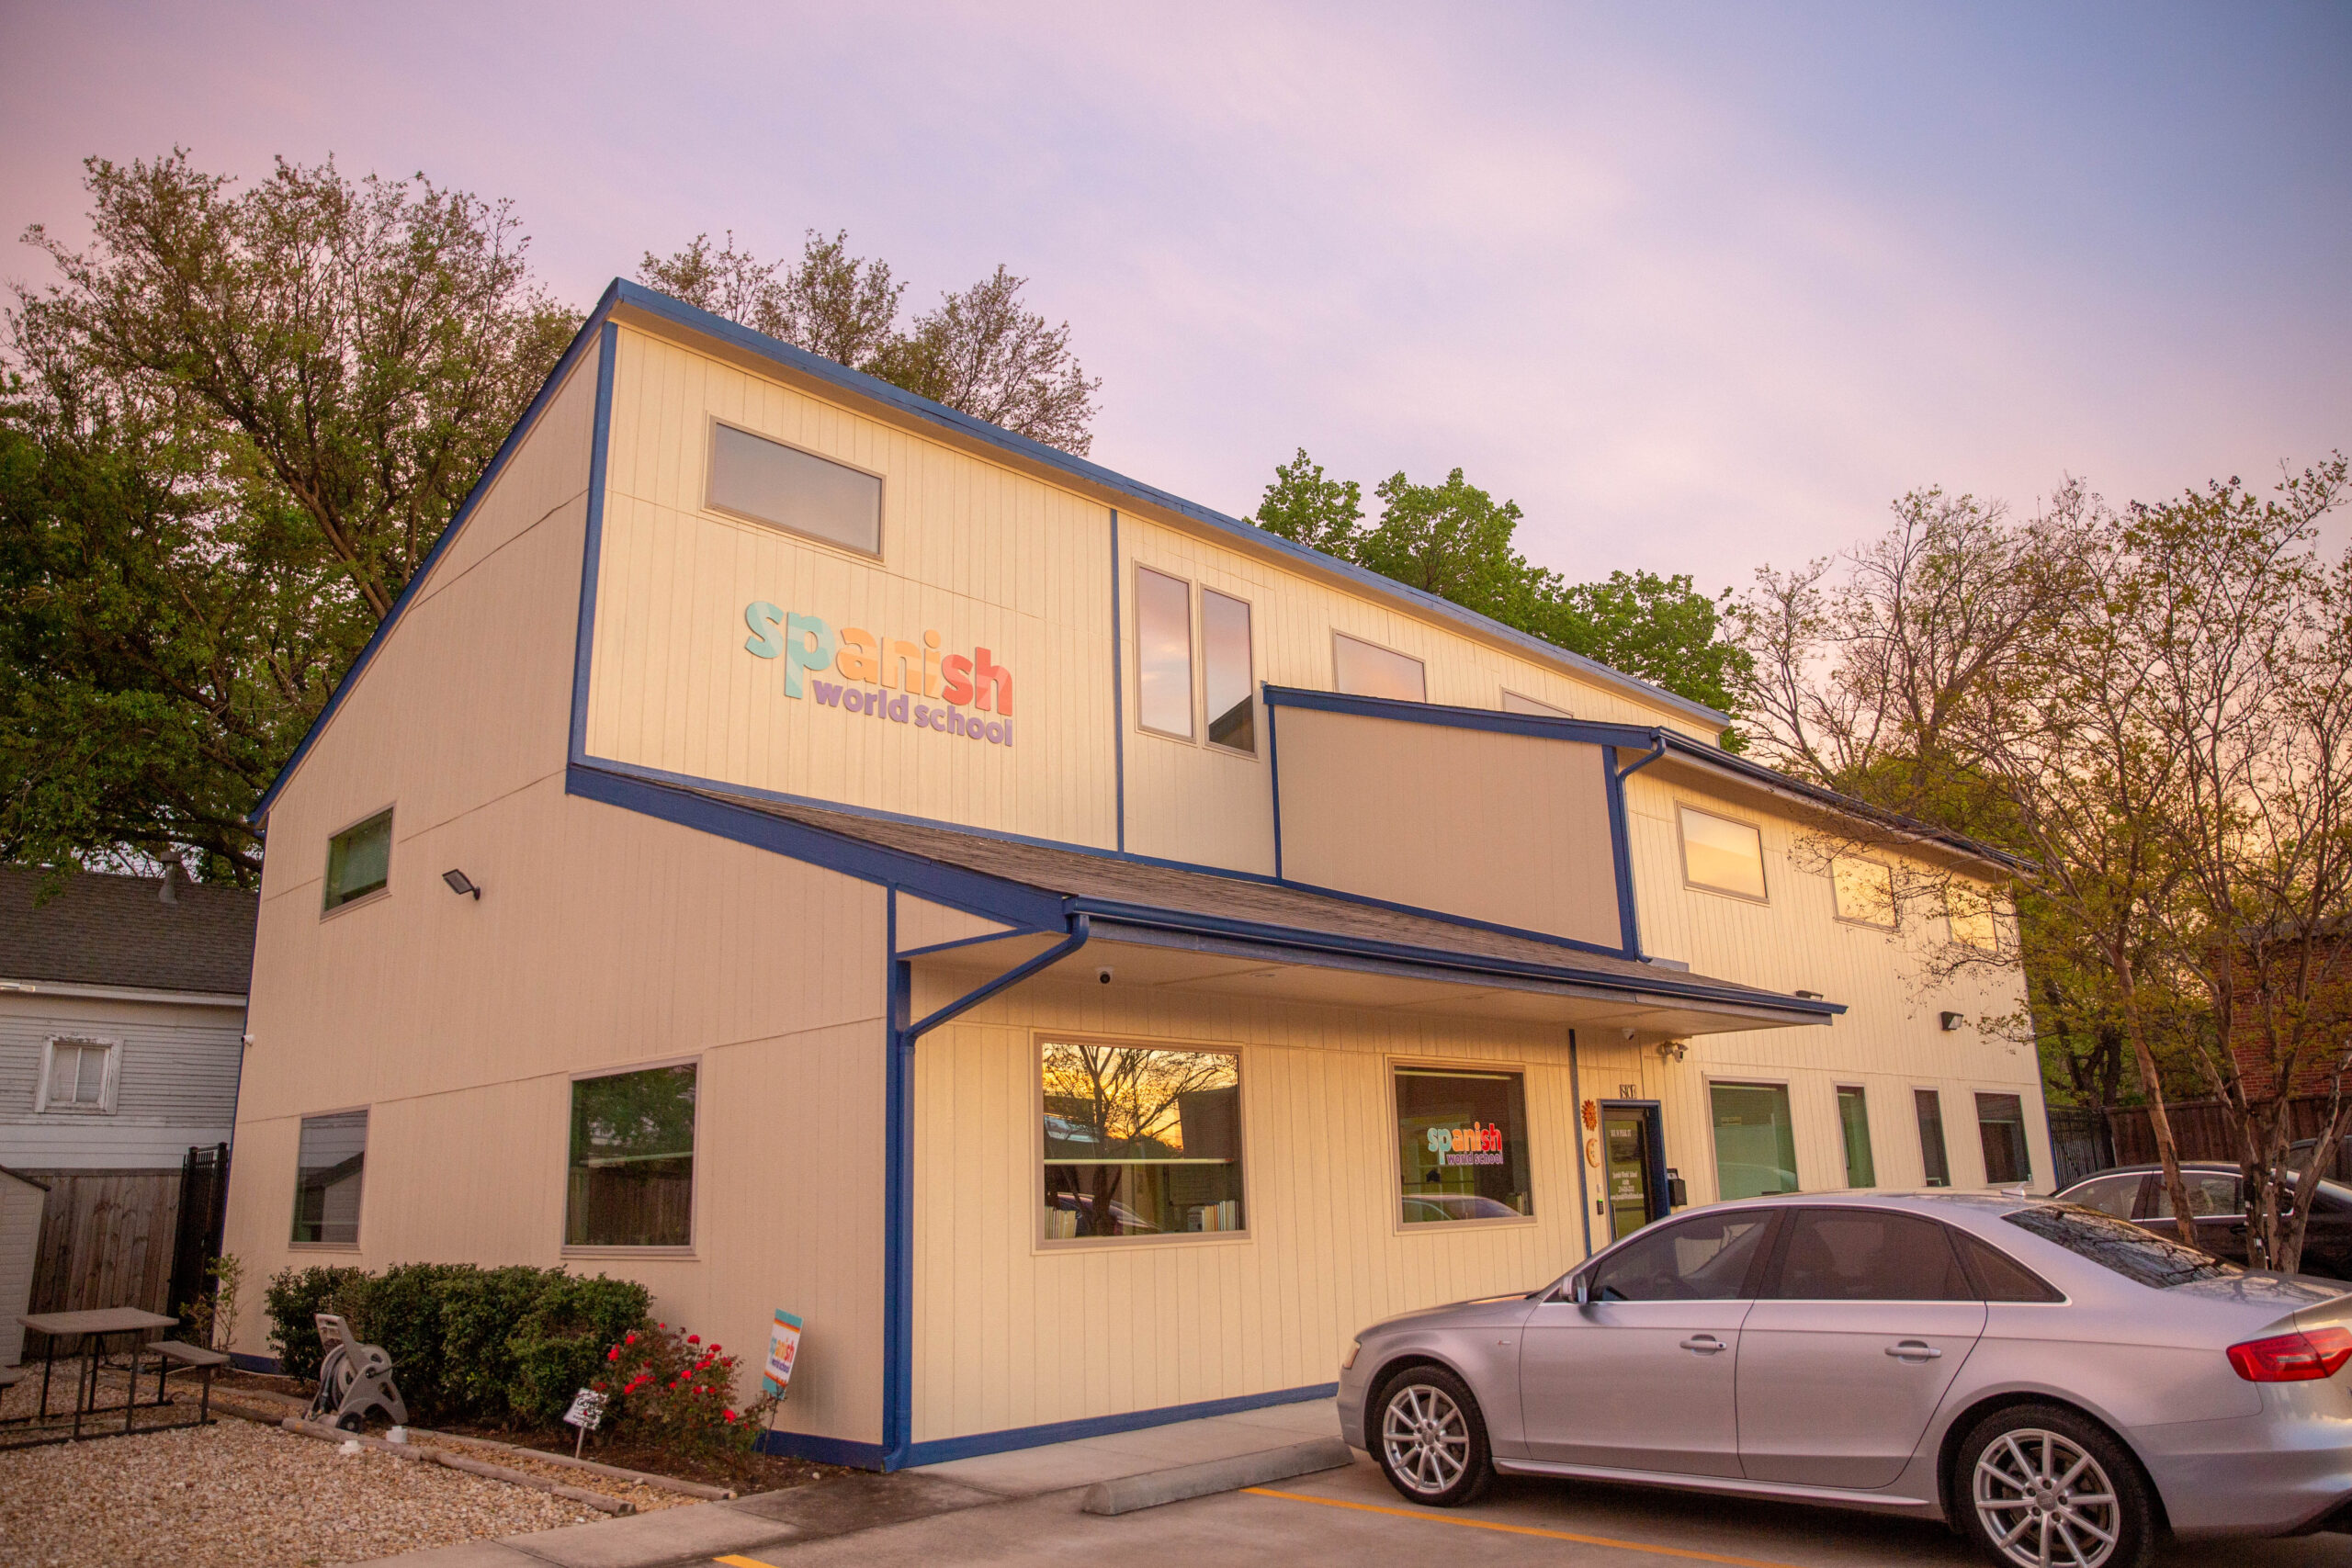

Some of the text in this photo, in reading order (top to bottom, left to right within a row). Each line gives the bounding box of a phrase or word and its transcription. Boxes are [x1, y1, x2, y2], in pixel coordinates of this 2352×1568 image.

[744, 601, 1013, 716] spanish
[812, 679, 1013, 747] world school
[1427, 1121, 1503, 1166] spanish
[1446, 1150, 1504, 1166] world school
